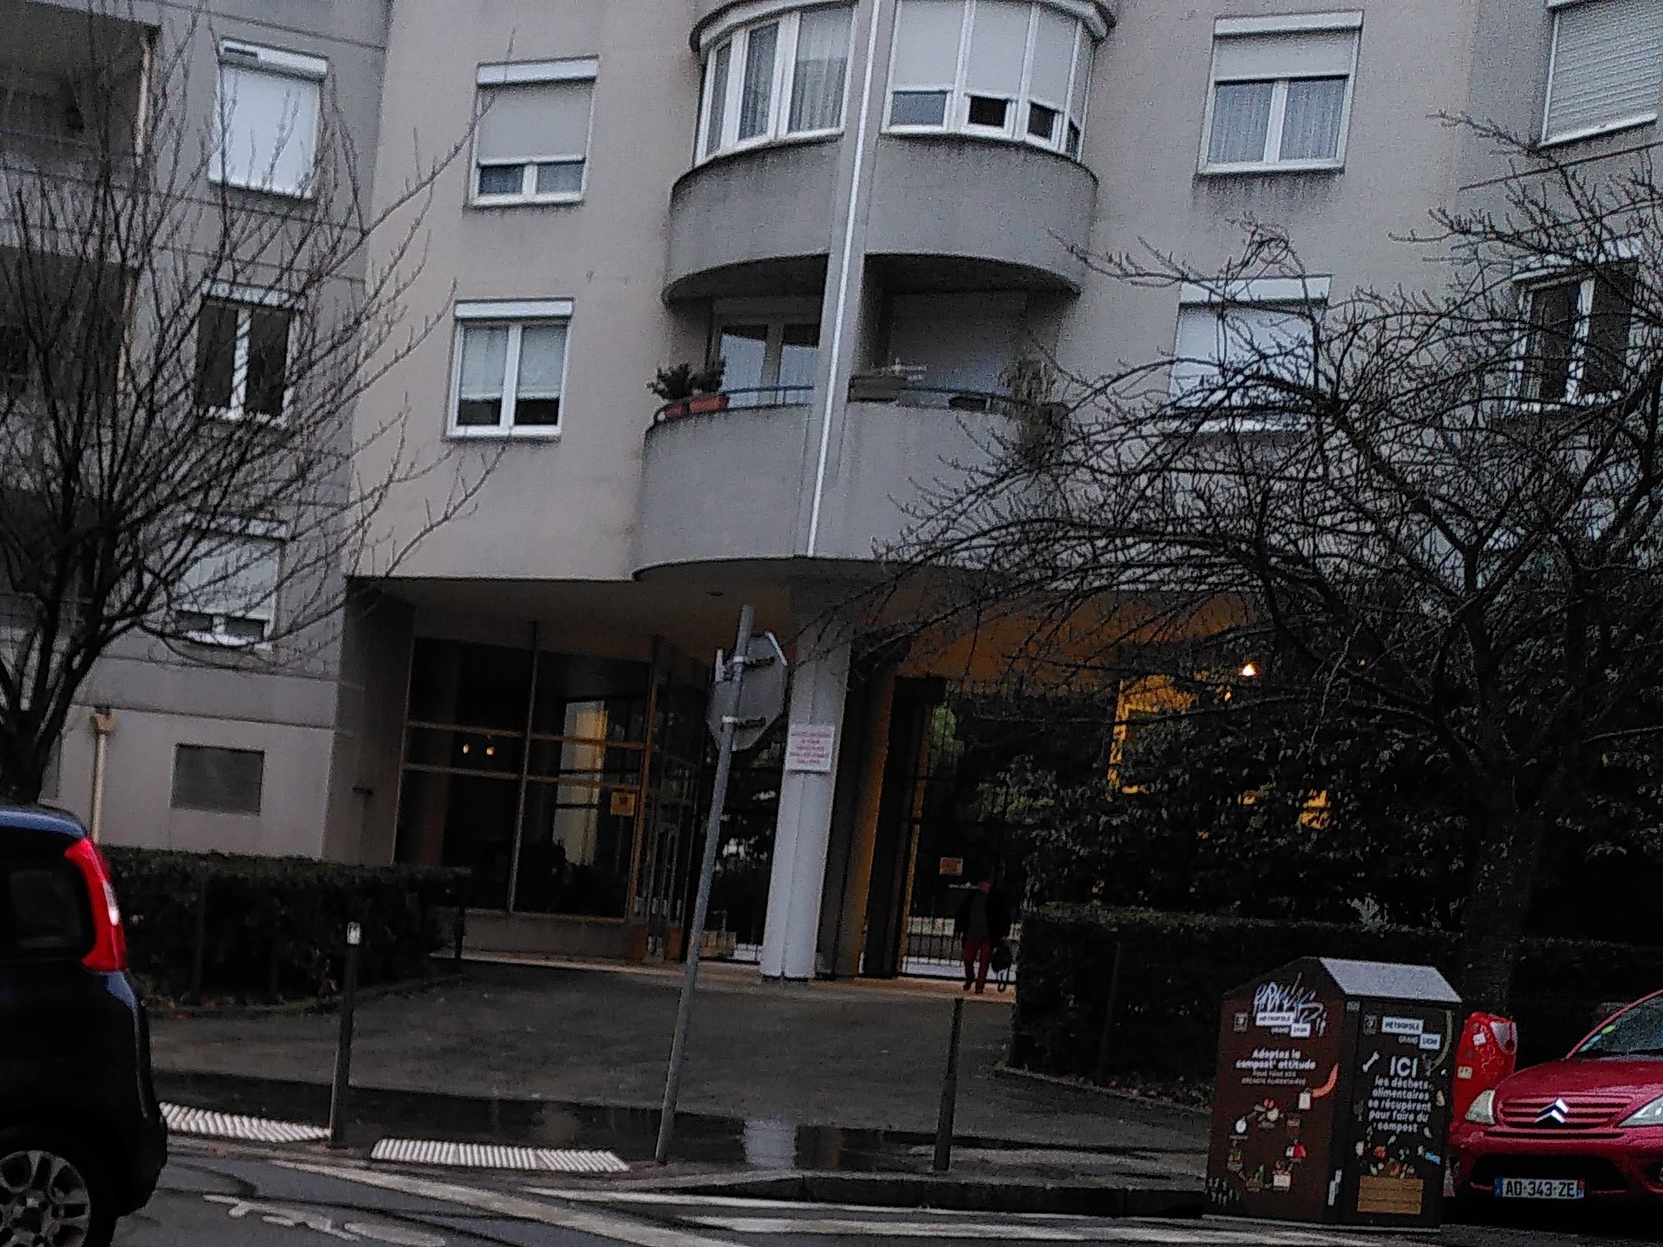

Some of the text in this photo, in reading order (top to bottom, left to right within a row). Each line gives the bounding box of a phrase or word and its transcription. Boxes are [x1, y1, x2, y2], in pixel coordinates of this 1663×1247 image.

[1389, 1055, 1418, 1078] ICI
[1374, 1075, 1390, 1088] les
[1372, 1087, 1429, 1100] alimentaires
[1367, 1098, 1380, 1110] se
[1368, 1109, 1430, 1124] pour faire du
[1377, 1121, 1418, 1135] compost
